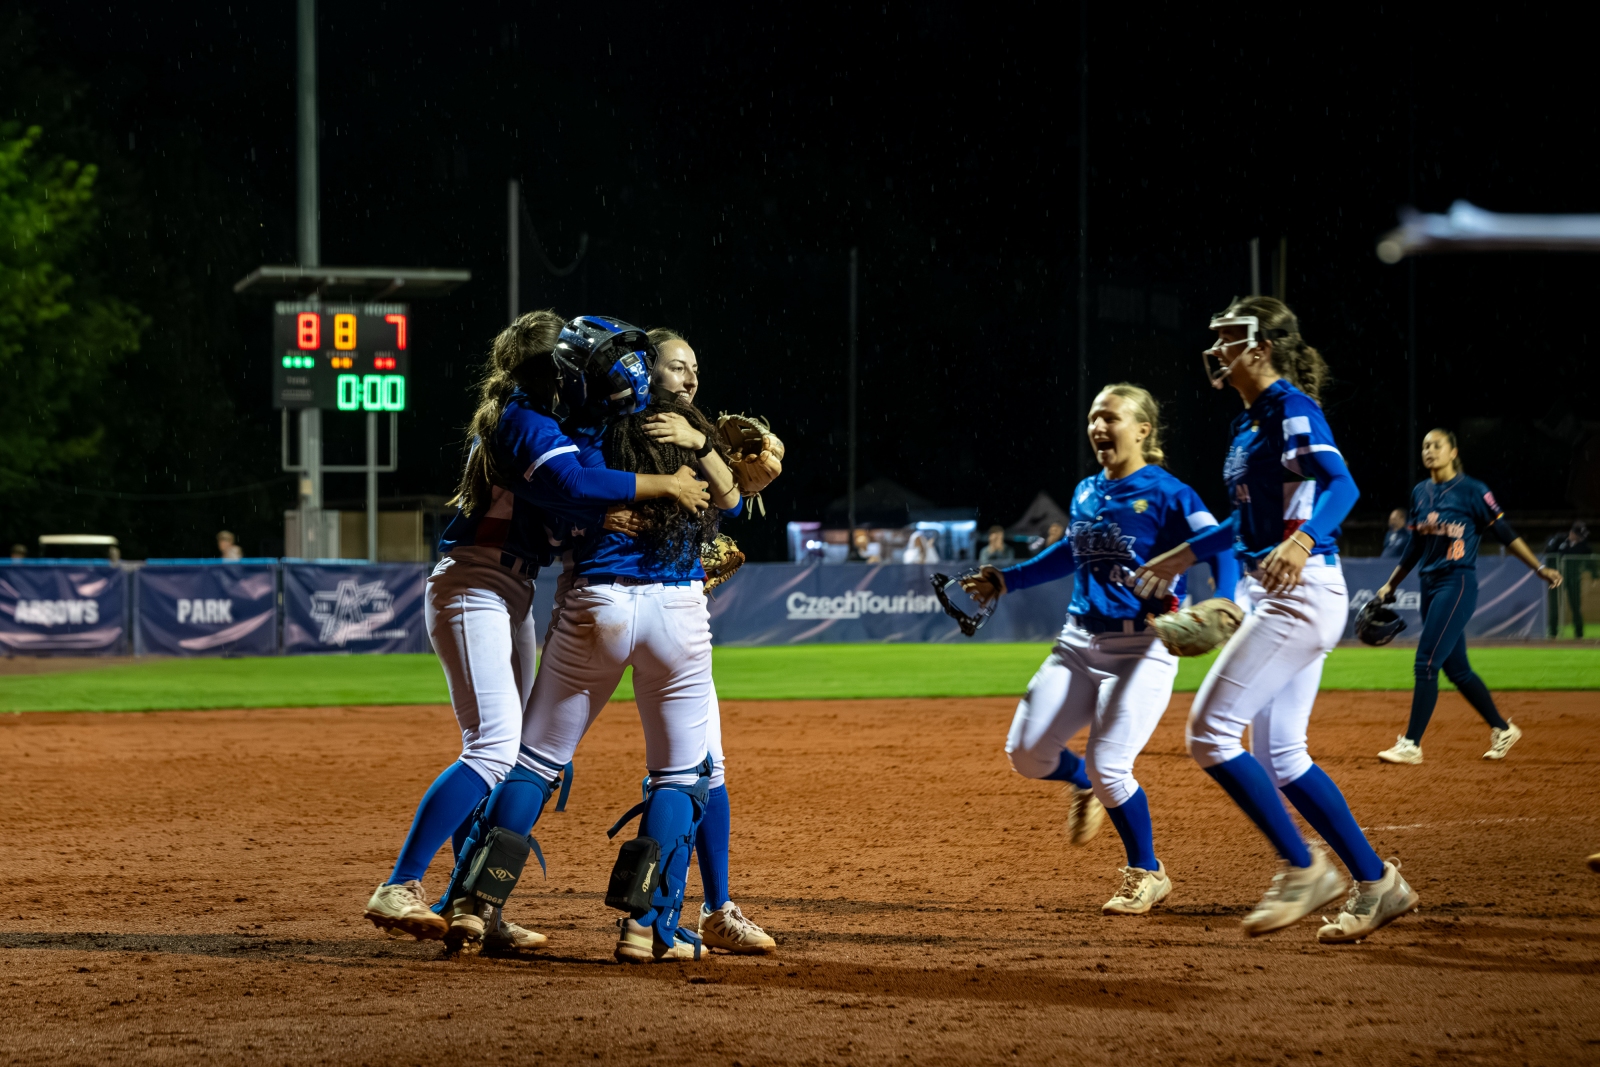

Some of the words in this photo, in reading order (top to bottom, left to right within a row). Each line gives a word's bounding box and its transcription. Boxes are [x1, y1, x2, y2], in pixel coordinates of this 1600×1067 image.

[297, 311, 321, 350] 8
[333, 313, 357, 350] 8
[384, 313, 407, 351] 7
[336, 373, 406, 411] 0:00
[176, 597, 234, 624] PARK
[786, 589, 943, 615] CzechTourism
[476, 889, 504, 905] WEDGE
